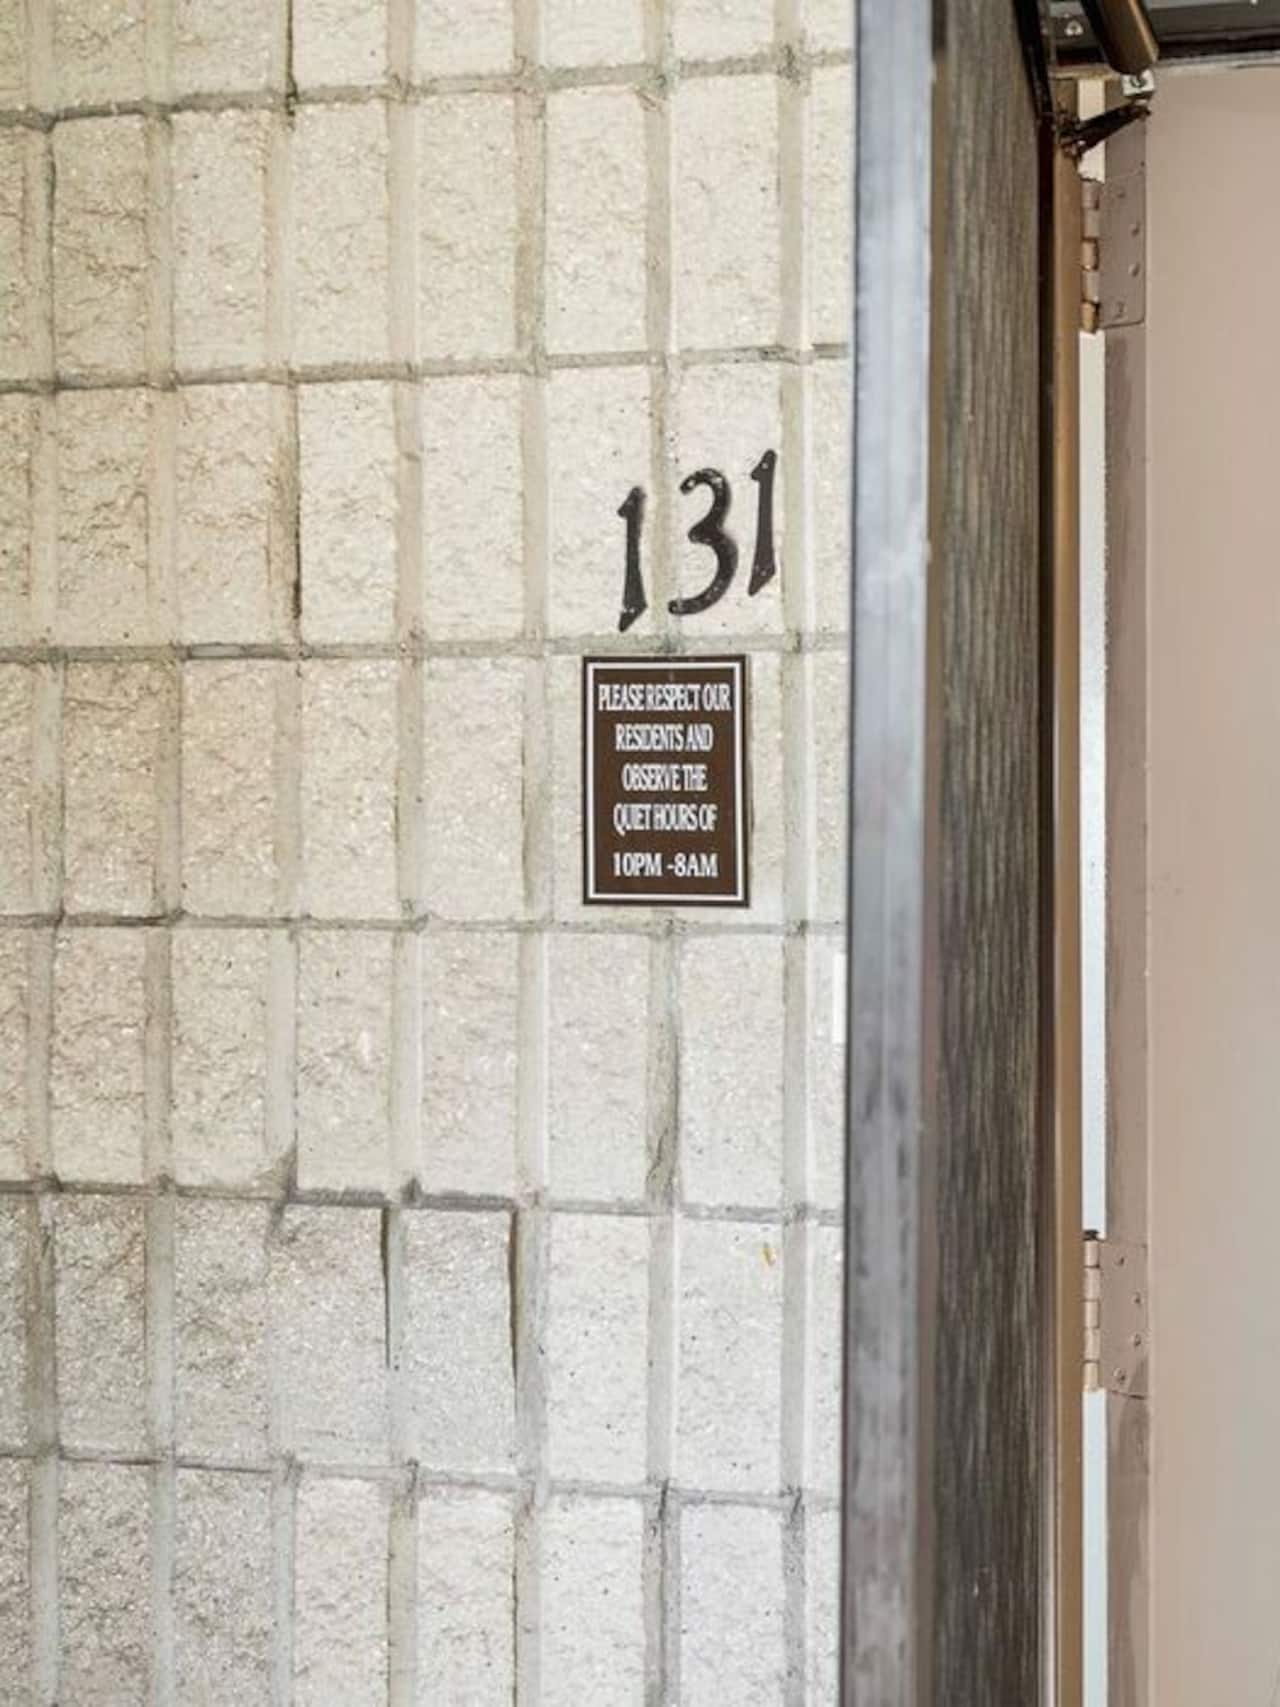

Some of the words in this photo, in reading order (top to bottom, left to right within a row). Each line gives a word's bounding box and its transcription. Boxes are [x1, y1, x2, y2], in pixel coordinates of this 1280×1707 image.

[617, 449, 777, 633] 131
[598, 684, 645, 711] PLEASE
[645, 684, 700, 711] RESPECT
[702, 684, 732, 711] OUR
[615, 724, 685, 751] RESIDENTS
[685, 724, 714, 751] AND
[622, 763, 681, 791] OBSERVE
[682, 764, 709, 791] THE
[613, 803, 653, 836] QUIET
[654, 804, 698, 831] HOURS
[699, 804, 718, 831] OF
[613, 852, 662, 877] 10PM
